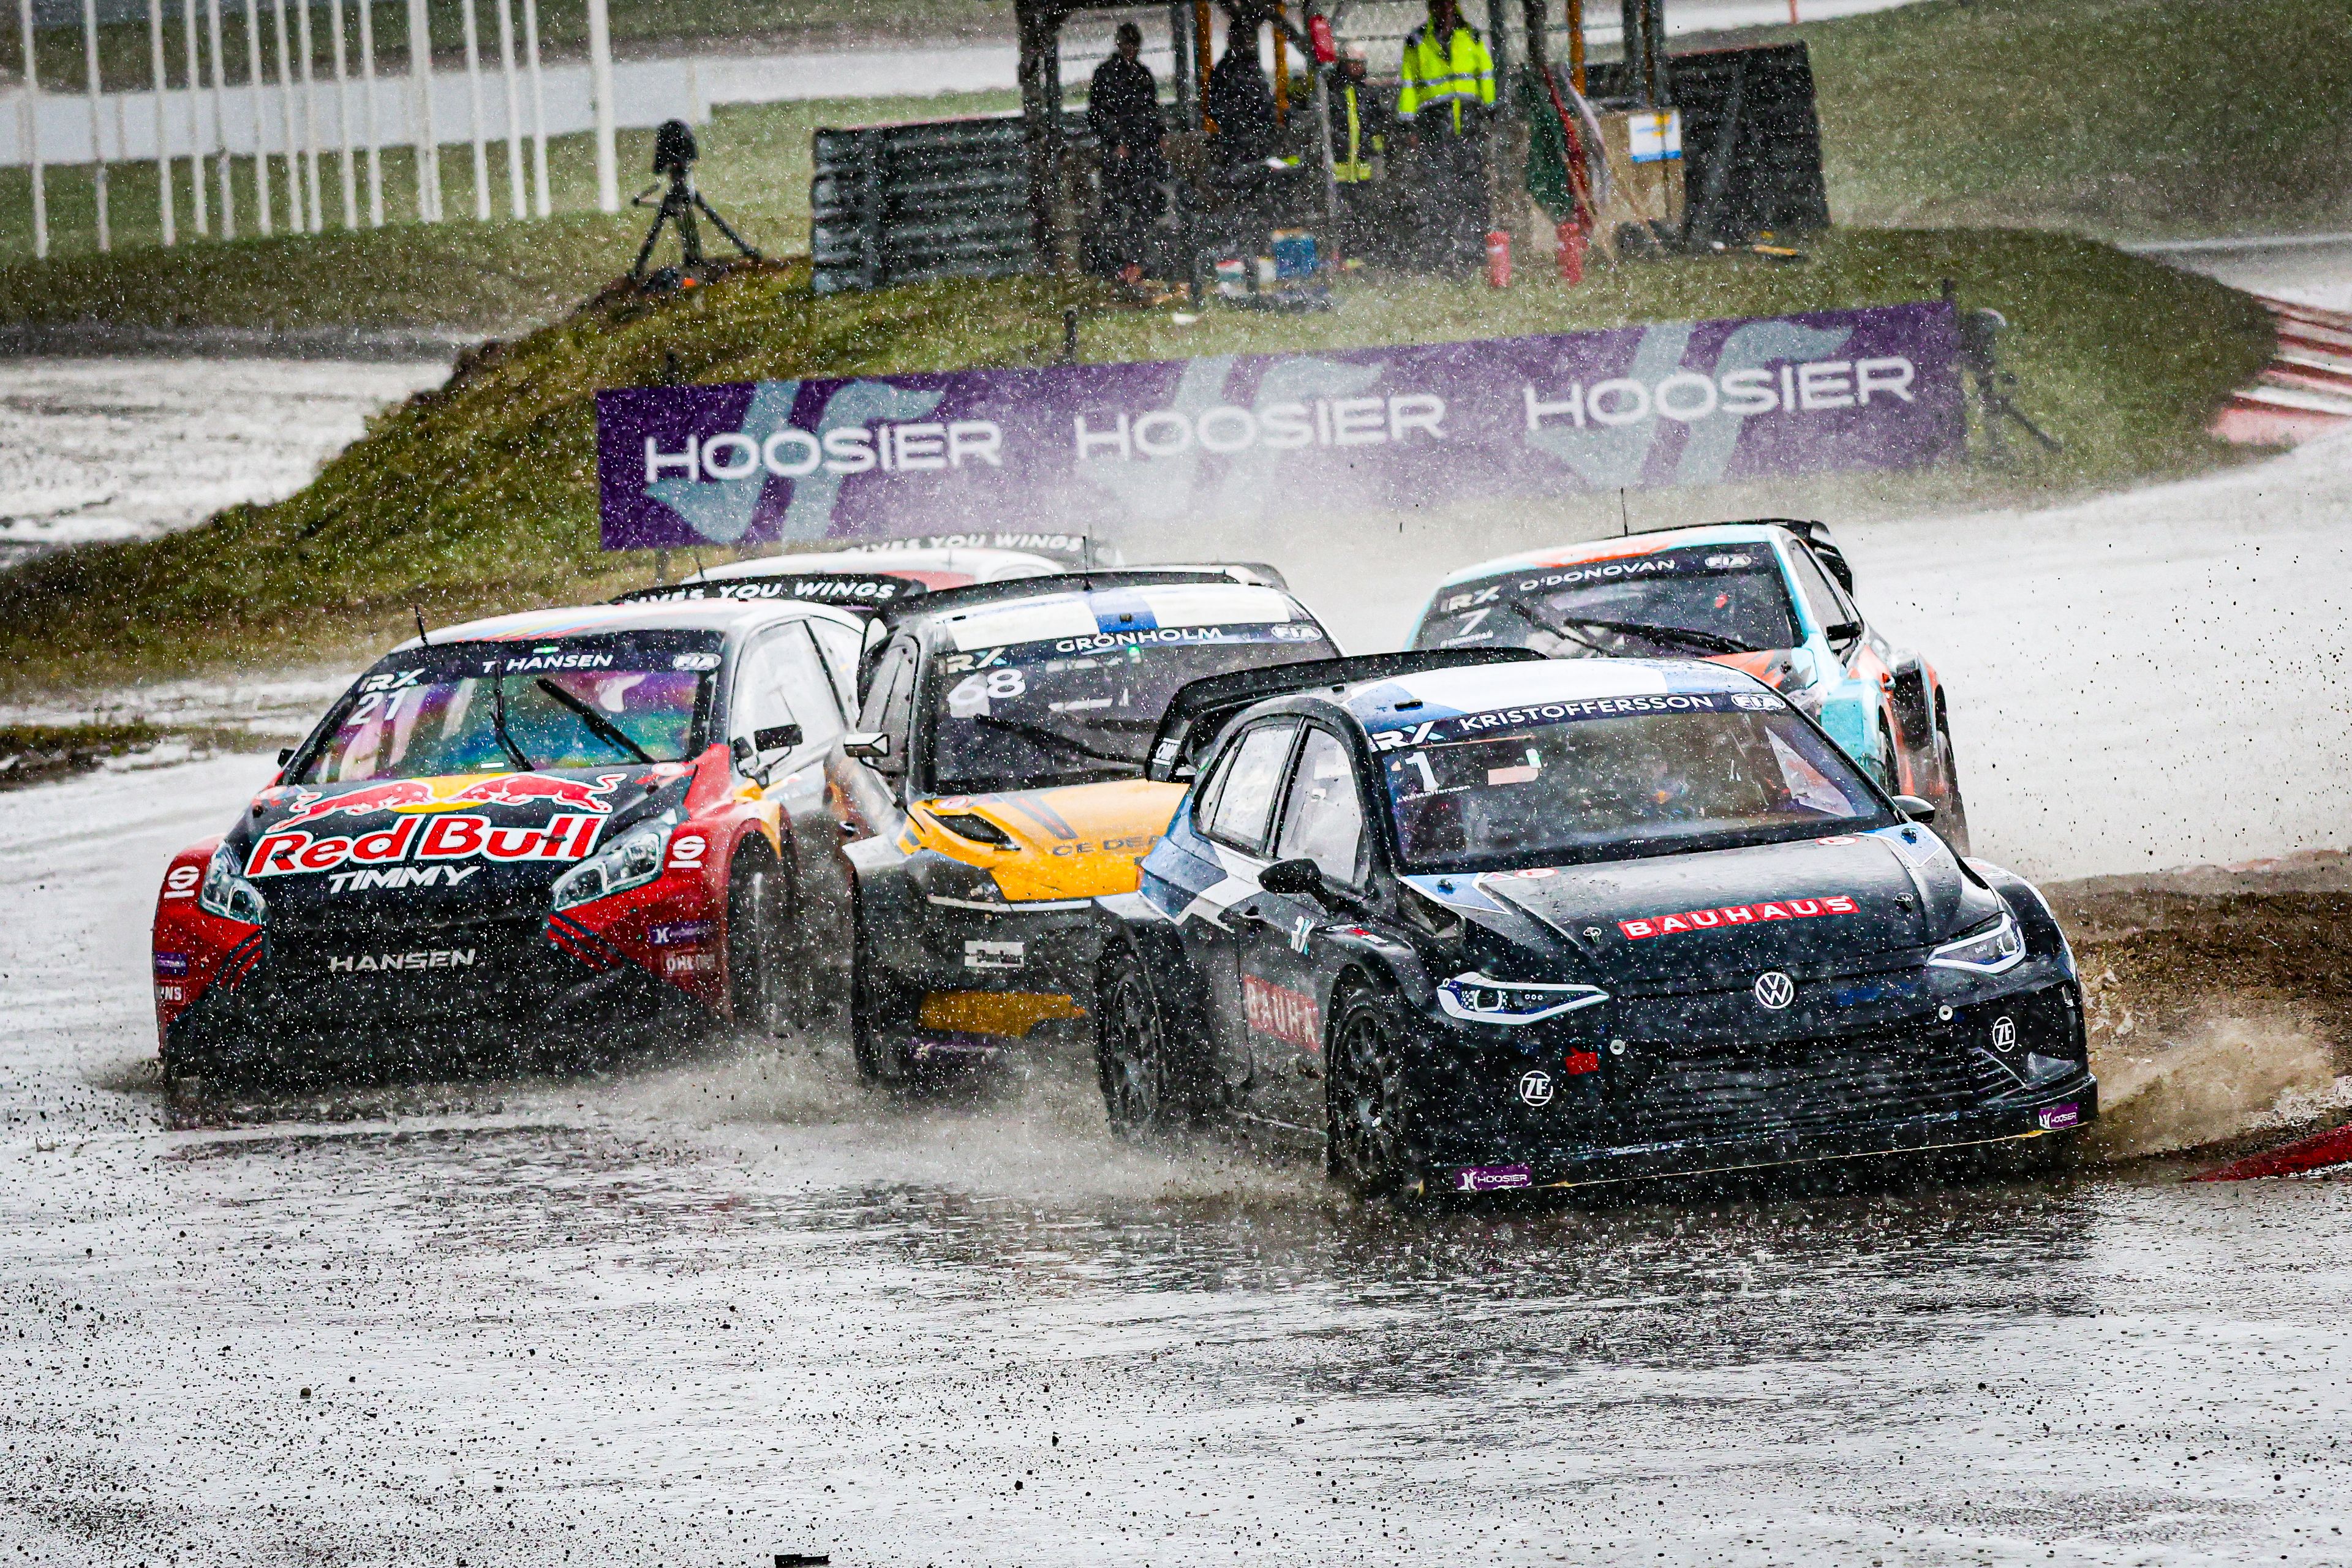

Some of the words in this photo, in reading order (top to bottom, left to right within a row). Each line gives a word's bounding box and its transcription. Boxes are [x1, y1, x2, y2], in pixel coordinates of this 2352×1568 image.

[1523, 358, 1916, 432] HOOSIER
[1075, 395, 1446, 460] HOOSIER
[646, 420, 1003, 483] HOOSIER
[931, 534, 986, 549] YOU
[994, 533, 1084, 551] WINGS
[719, 584, 780, 599] YOU
[794, 581, 897, 599] WINGS
[1518, 558, 1676, 592] O'DONOVAN
[1273, 625, 1319, 640] FIA
[1458, 607, 1491, 637] 7
[506, 654, 612, 672] HANSEN
[674, 654, 718, 668] FIA
[948, 668, 1027, 705] 68
[347, 686, 409, 727] 21
[1459, 695, 1714, 732] KRISTOFFERSSON
[1732, 694, 1784, 710] FIA
[1404, 751, 1438, 790] 1
[244, 813, 417, 878] Red
[415, 812, 606, 861] Bull
[329, 865, 480, 894] TIMMY
[1625, 895, 1853, 938] BAUHAUS
[328, 949, 476, 973] HANSEN
[1994, 1019, 2015, 1049] ZF
[1521, 1074, 1552, 1102] ZF
[1477, 1174, 1528, 1185] HOOSIER
